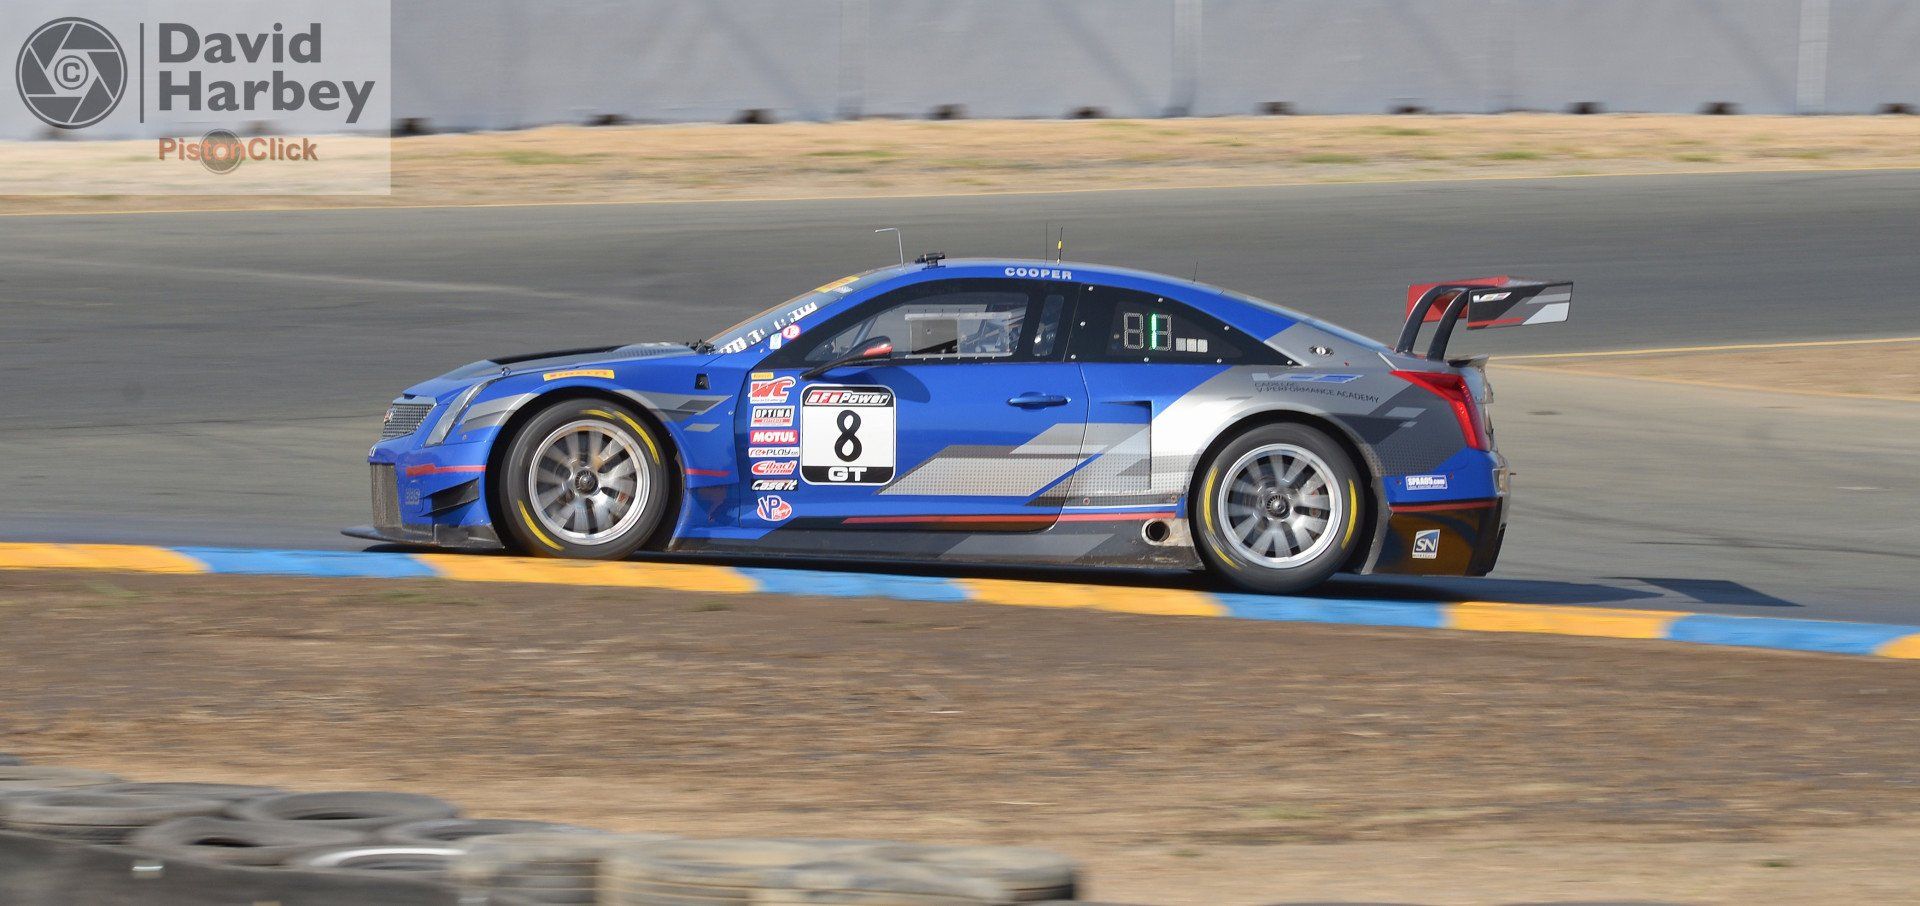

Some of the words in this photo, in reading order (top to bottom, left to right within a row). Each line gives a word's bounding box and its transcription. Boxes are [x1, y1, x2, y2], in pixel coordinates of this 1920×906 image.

[1004, 267, 1072, 280] COOPER
[1336, 390, 1379, 403] ACADEMY
[755, 408, 792, 418] OPTIMA
[752, 431, 796, 443] MOTUL
[834, 409, 863, 463] 8
[828, 466, 868, 482] GT
[758, 496, 781, 520] VP
[1416, 538, 1436, 551] SN
